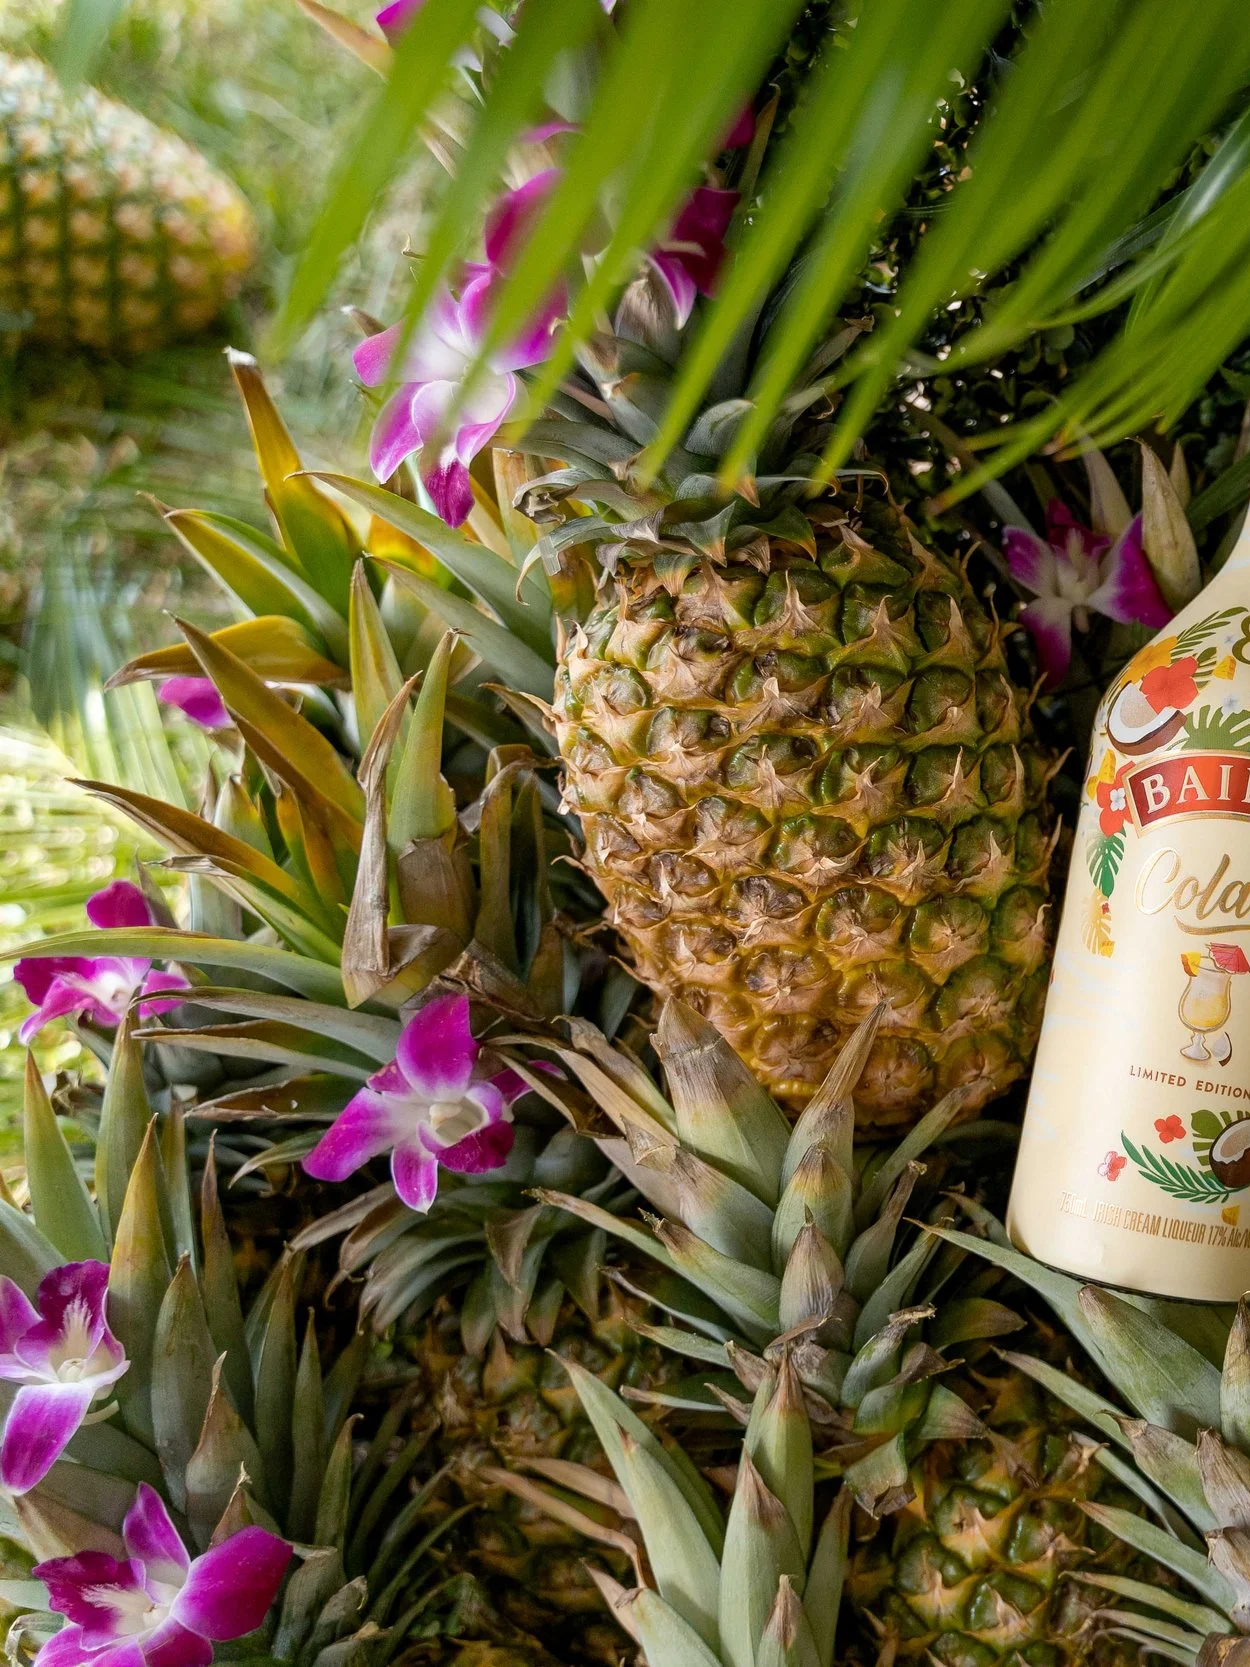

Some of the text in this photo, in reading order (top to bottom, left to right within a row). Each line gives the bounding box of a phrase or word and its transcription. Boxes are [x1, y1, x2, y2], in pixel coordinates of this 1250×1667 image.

[1130, 1065, 1187, 1087] LIMITED
[1122, 1208, 1161, 1237] CREAM
[1162, 1217, 1206, 1245] LIQUEUR
[1207, 1225, 1227, 1248] 17%
